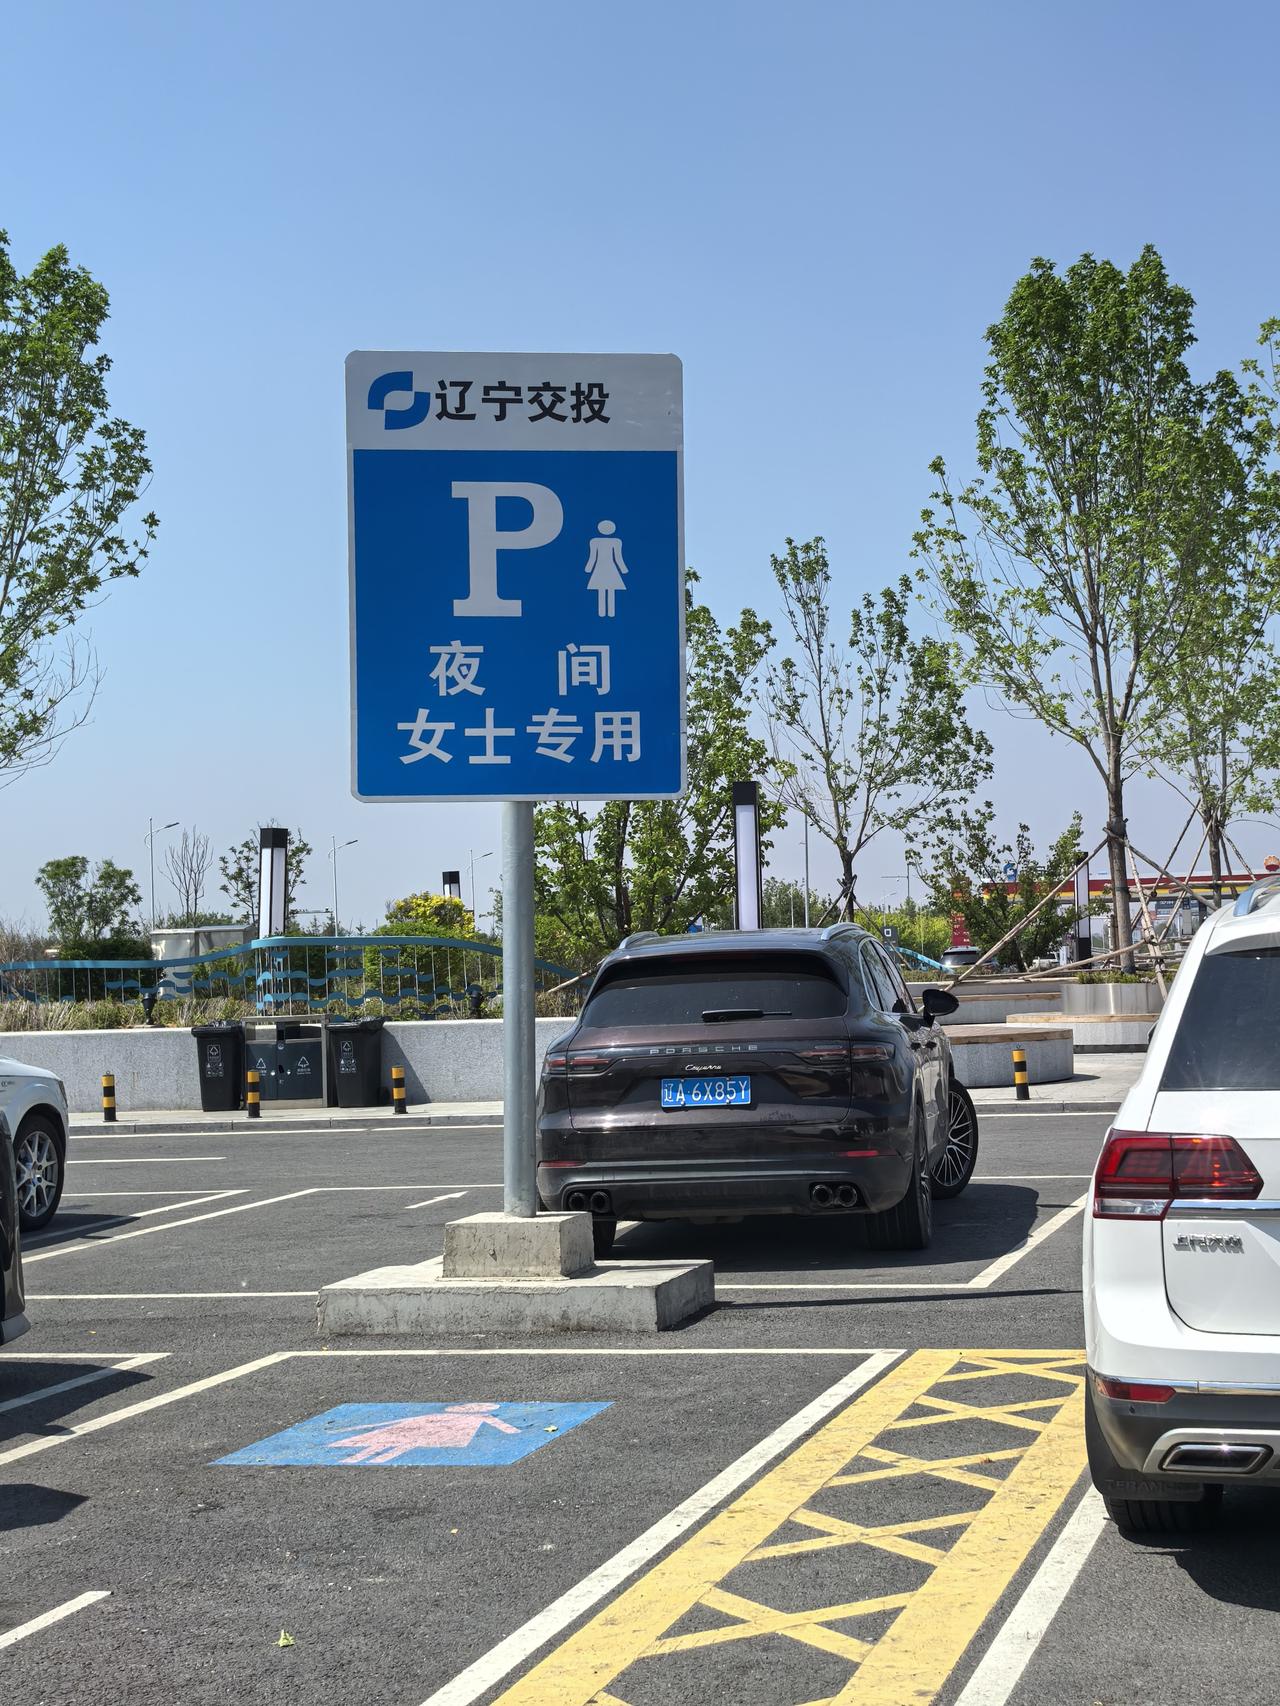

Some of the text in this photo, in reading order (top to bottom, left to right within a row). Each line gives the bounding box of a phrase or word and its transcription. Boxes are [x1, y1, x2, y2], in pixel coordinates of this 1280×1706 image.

[434, 379, 611, 424] 辽宁交投
[451, 481, 564, 617] P
[396, 707, 642, 765] 女士专用
[649, 1044, 758, 1055] PORSCHE
